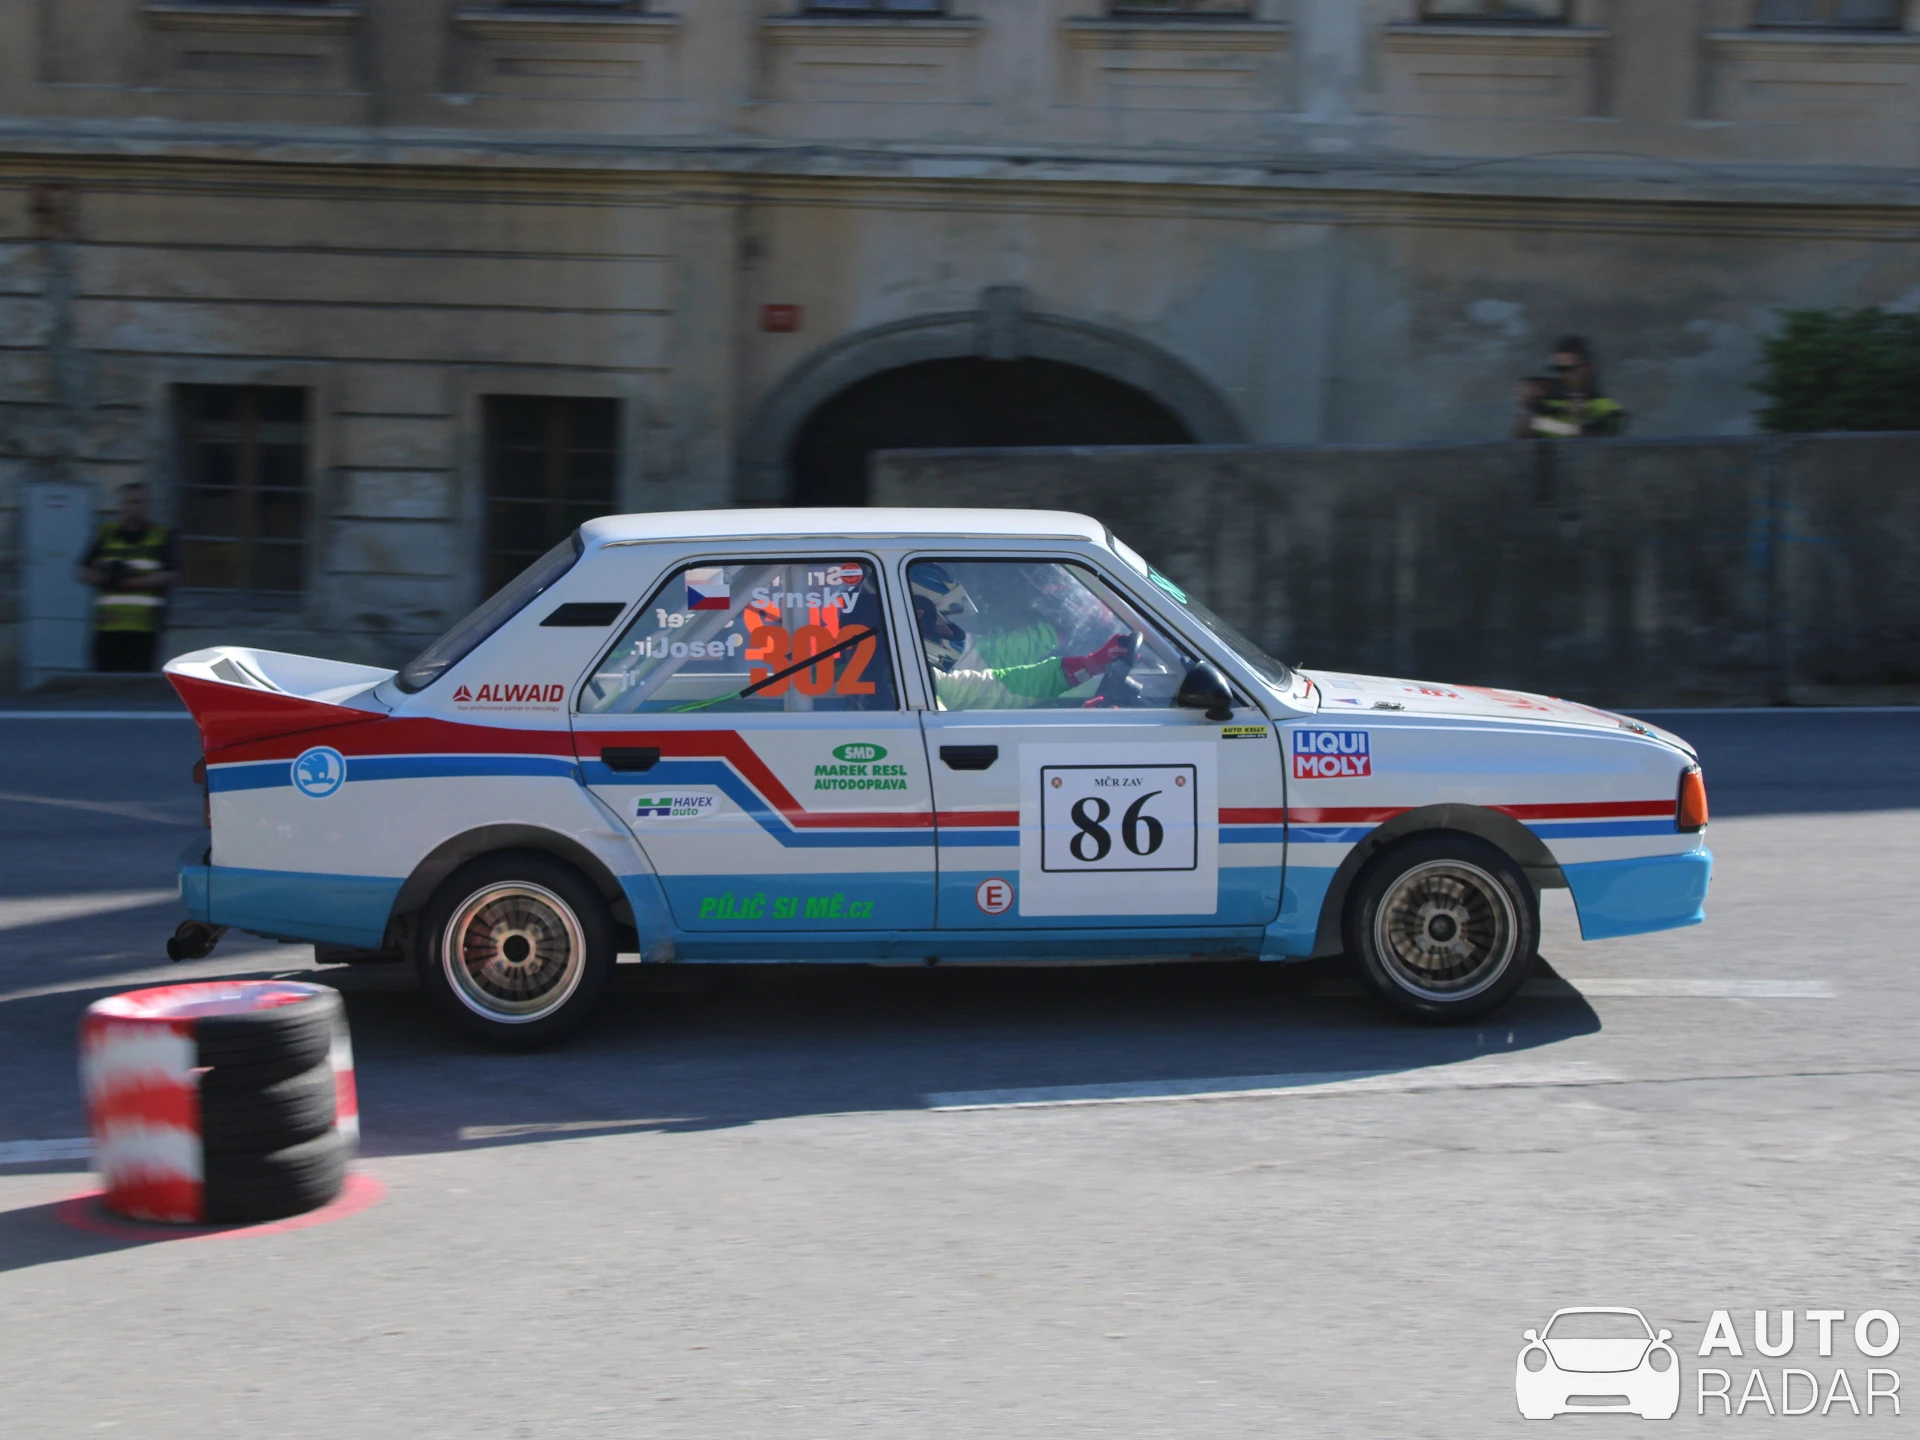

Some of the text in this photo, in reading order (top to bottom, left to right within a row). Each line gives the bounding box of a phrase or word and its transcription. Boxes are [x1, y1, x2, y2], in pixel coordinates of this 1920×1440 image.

[751, 586, 859, 614] Srnský
[652, 633, 738, 659] Josef
[750, 624, 876, 697] 302
[620, 664, 646, 692] jr.
[475, 684, 565, 702] ALWAID
[845, 746, 876, 759] SMD
[1297, 732, 1366, 754] LIQUI
[814, 765, 907, 776] MAREK RESL
[1297, 756, 1368, 777] MOLY
[814, 779, 907, 790] AUTODOPRAVA
[1094, 776, 1144, 787] MČR ZAV
[672, 807, 699, 816] auto
[674, 797, 713, 807] HAVEX
[1069, 790, 1164, 862] 86
[699, 891, 766, 920] PŮJČ
[772, 897, 799, 919] SI
[987, 886, 1003, 906] E
